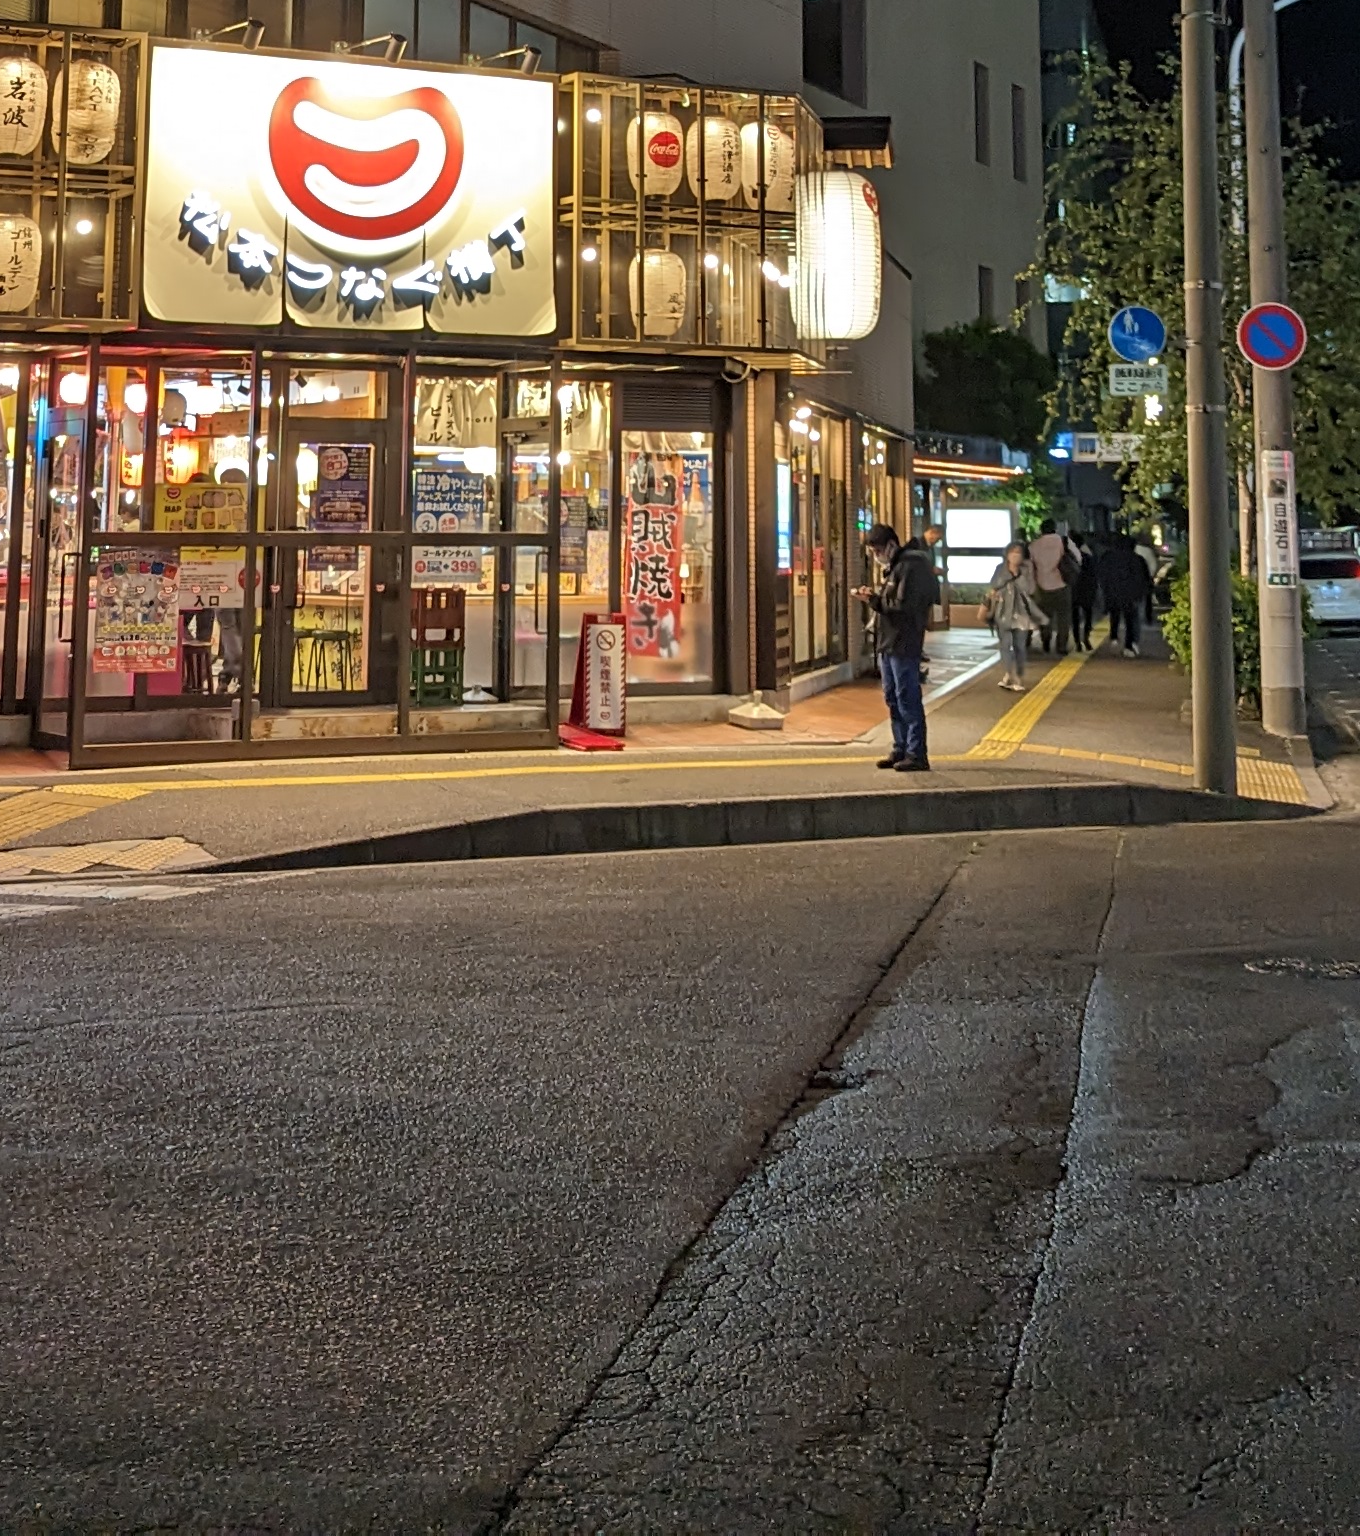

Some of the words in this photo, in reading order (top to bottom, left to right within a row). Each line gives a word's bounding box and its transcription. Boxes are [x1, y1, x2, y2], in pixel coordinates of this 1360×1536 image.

[3, 76, 29, 128] 岩波
[22, 227, 33, 252] 信州
[181, 191, 528, 304] 松本つなぐ横丁
[7, 229, 24, 292] ゴールデン
[1114, 381, 1164, 392] ここから
[428, 405, 443, 442] ビール
[445, 393, 456, 441] オリオン
[163, 505, 182, 514] MAP
[423, 549, 474, 558] ゴールデンタイム
[451, 560, 477, 572] 399
[193, 595, 220, 607] 入口
[599, 655, 612, 708] 喫煙禁止
